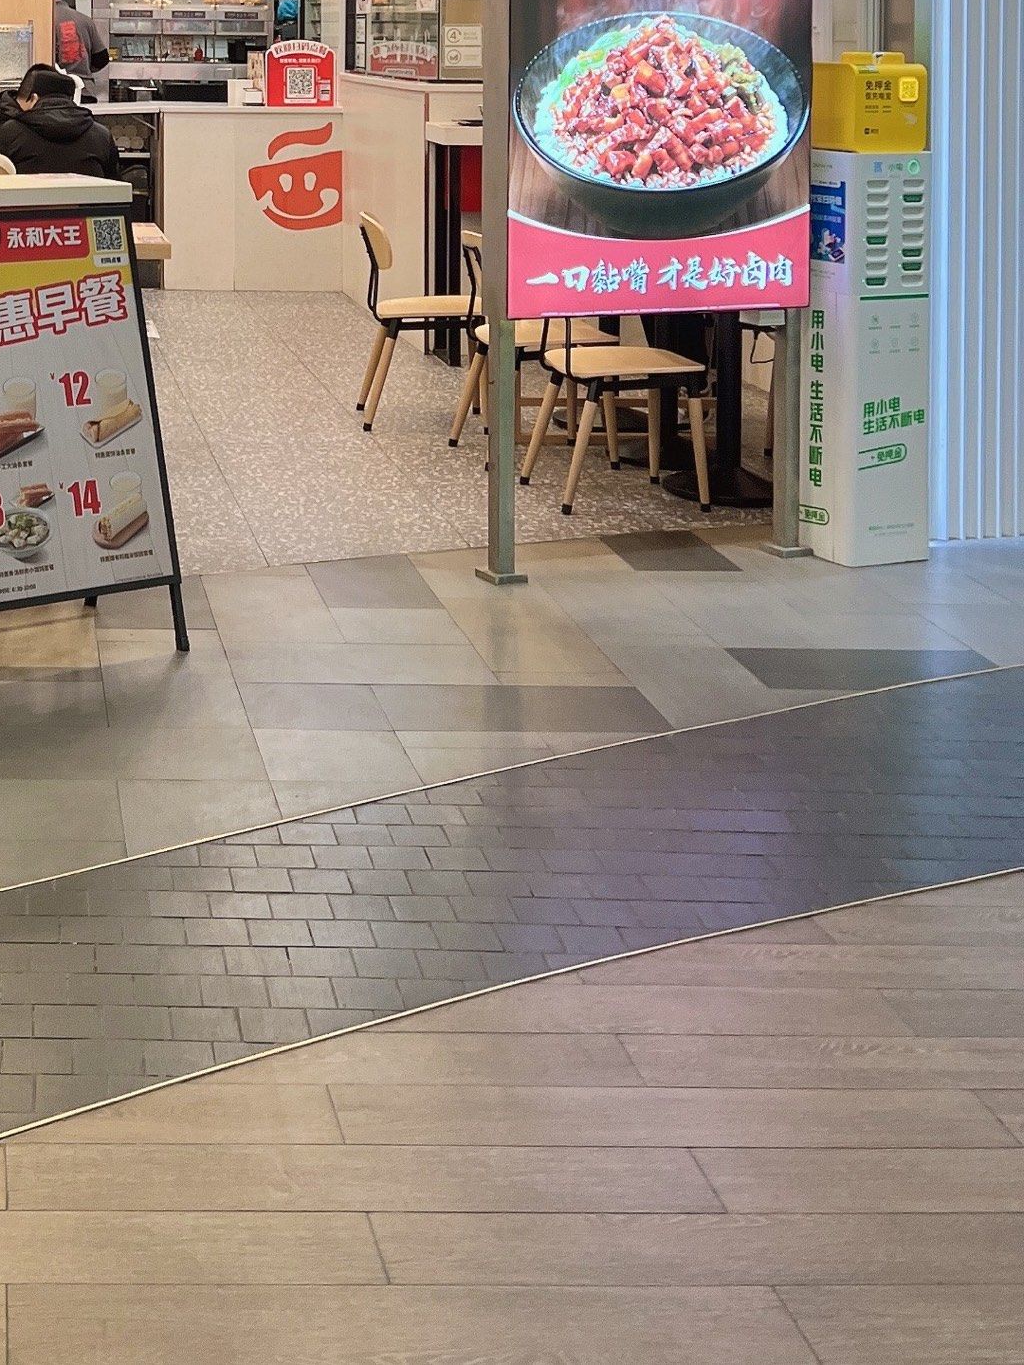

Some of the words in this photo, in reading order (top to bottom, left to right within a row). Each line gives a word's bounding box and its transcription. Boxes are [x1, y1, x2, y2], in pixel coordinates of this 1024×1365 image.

[865, 79, 892, 91] 免押金
[6, 225, 82, 250] 永和大王
[655, 251, 794, 291] 才是好卤肉
[809, 309, 825, 373] 用小电
[863, 396, 901, 418] 用小电
[808, 379, 824, 487] 生活不断电
[863, 409, 925, 435] 生活不断电
